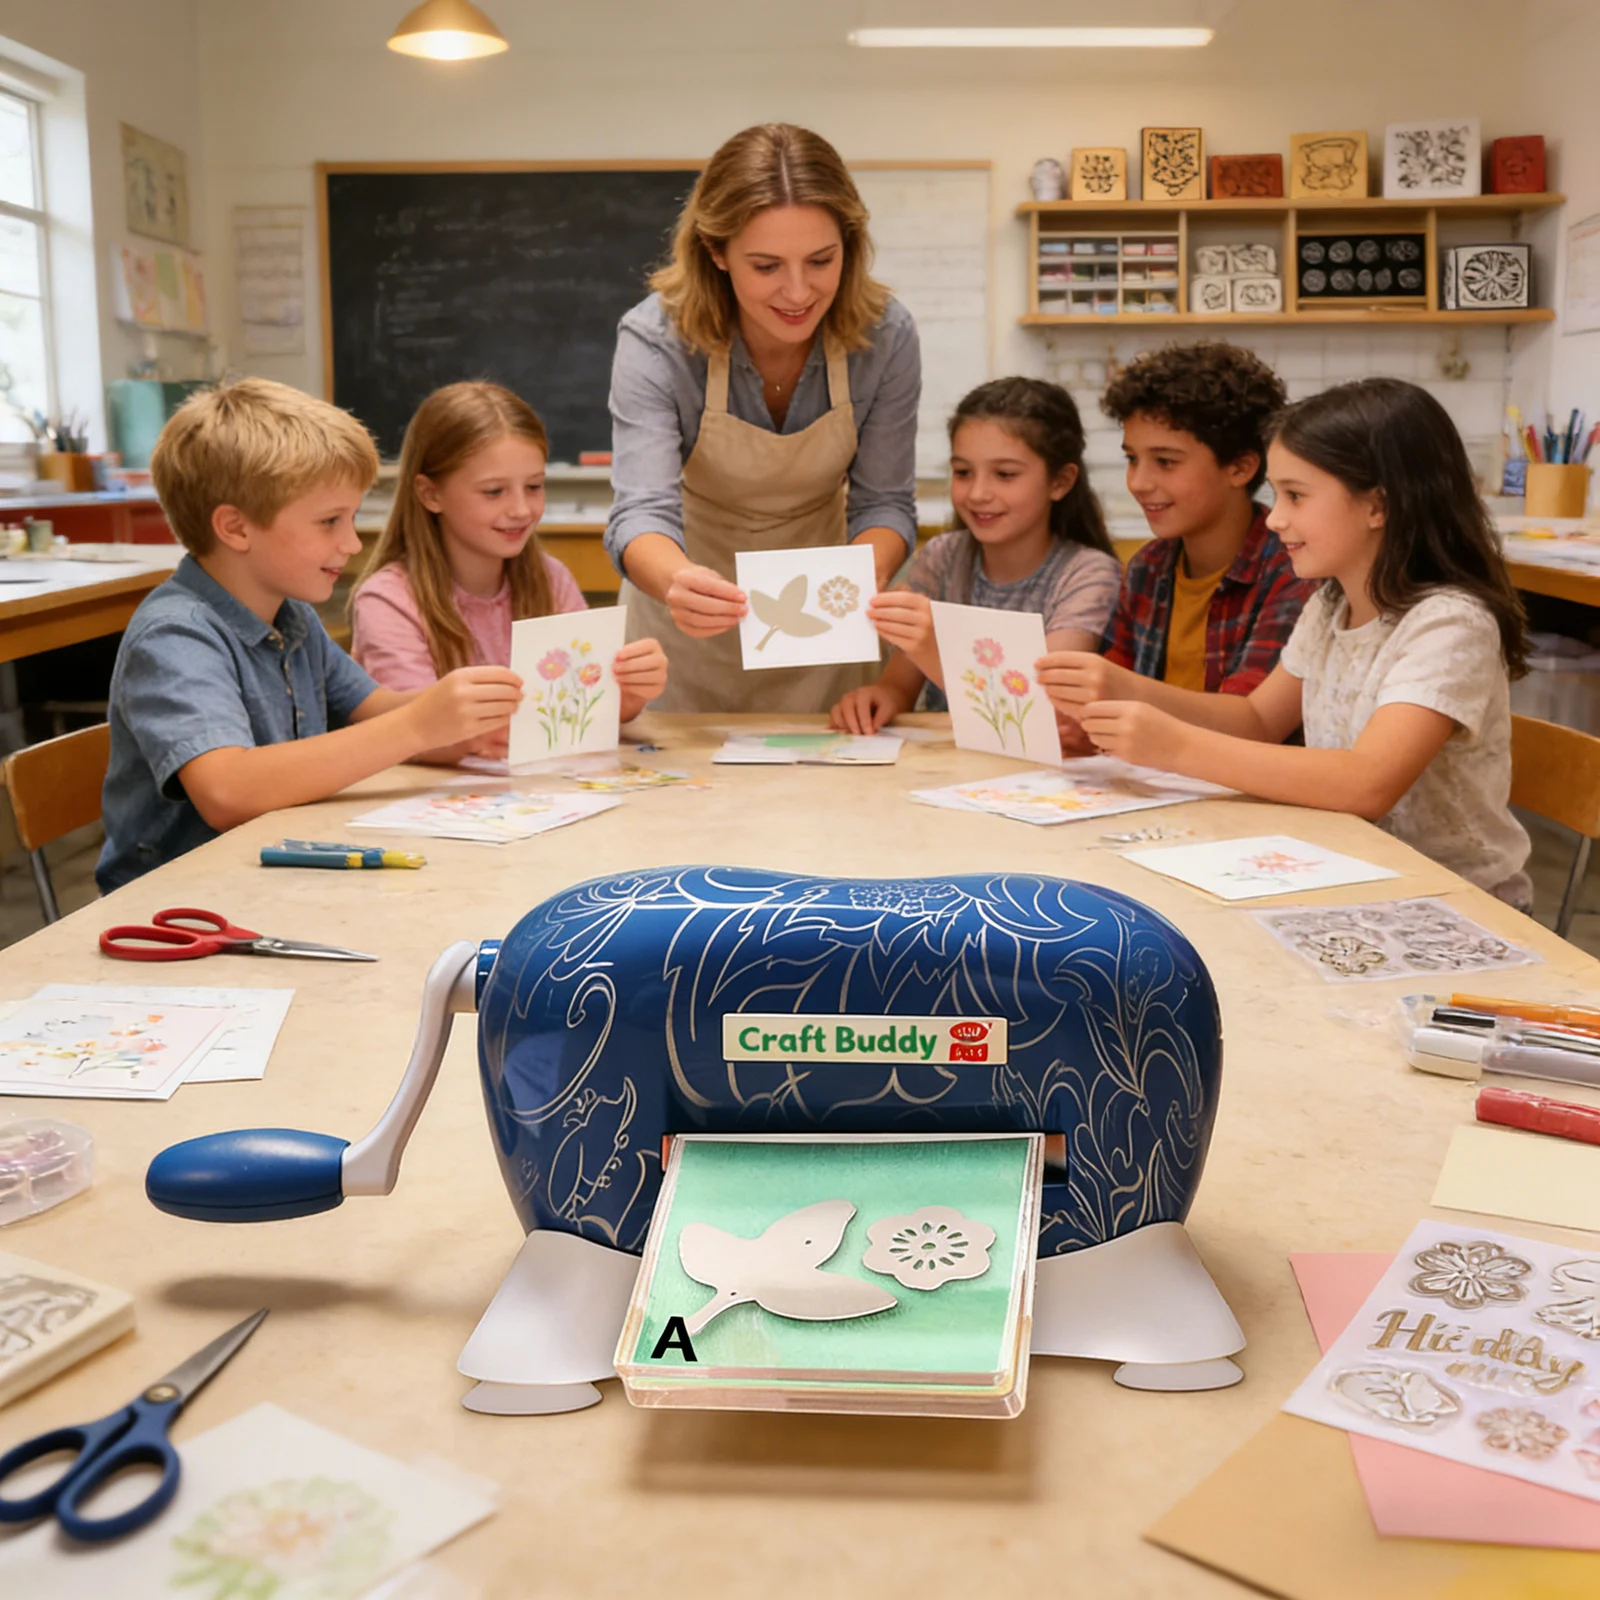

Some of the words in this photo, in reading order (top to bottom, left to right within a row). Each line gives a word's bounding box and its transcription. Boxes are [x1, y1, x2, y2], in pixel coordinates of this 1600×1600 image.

[738, 1025, 826, 1052] Craft
[836, 1025, 938, 1060] Buddy
[650, 1316, 698, 1362] A
